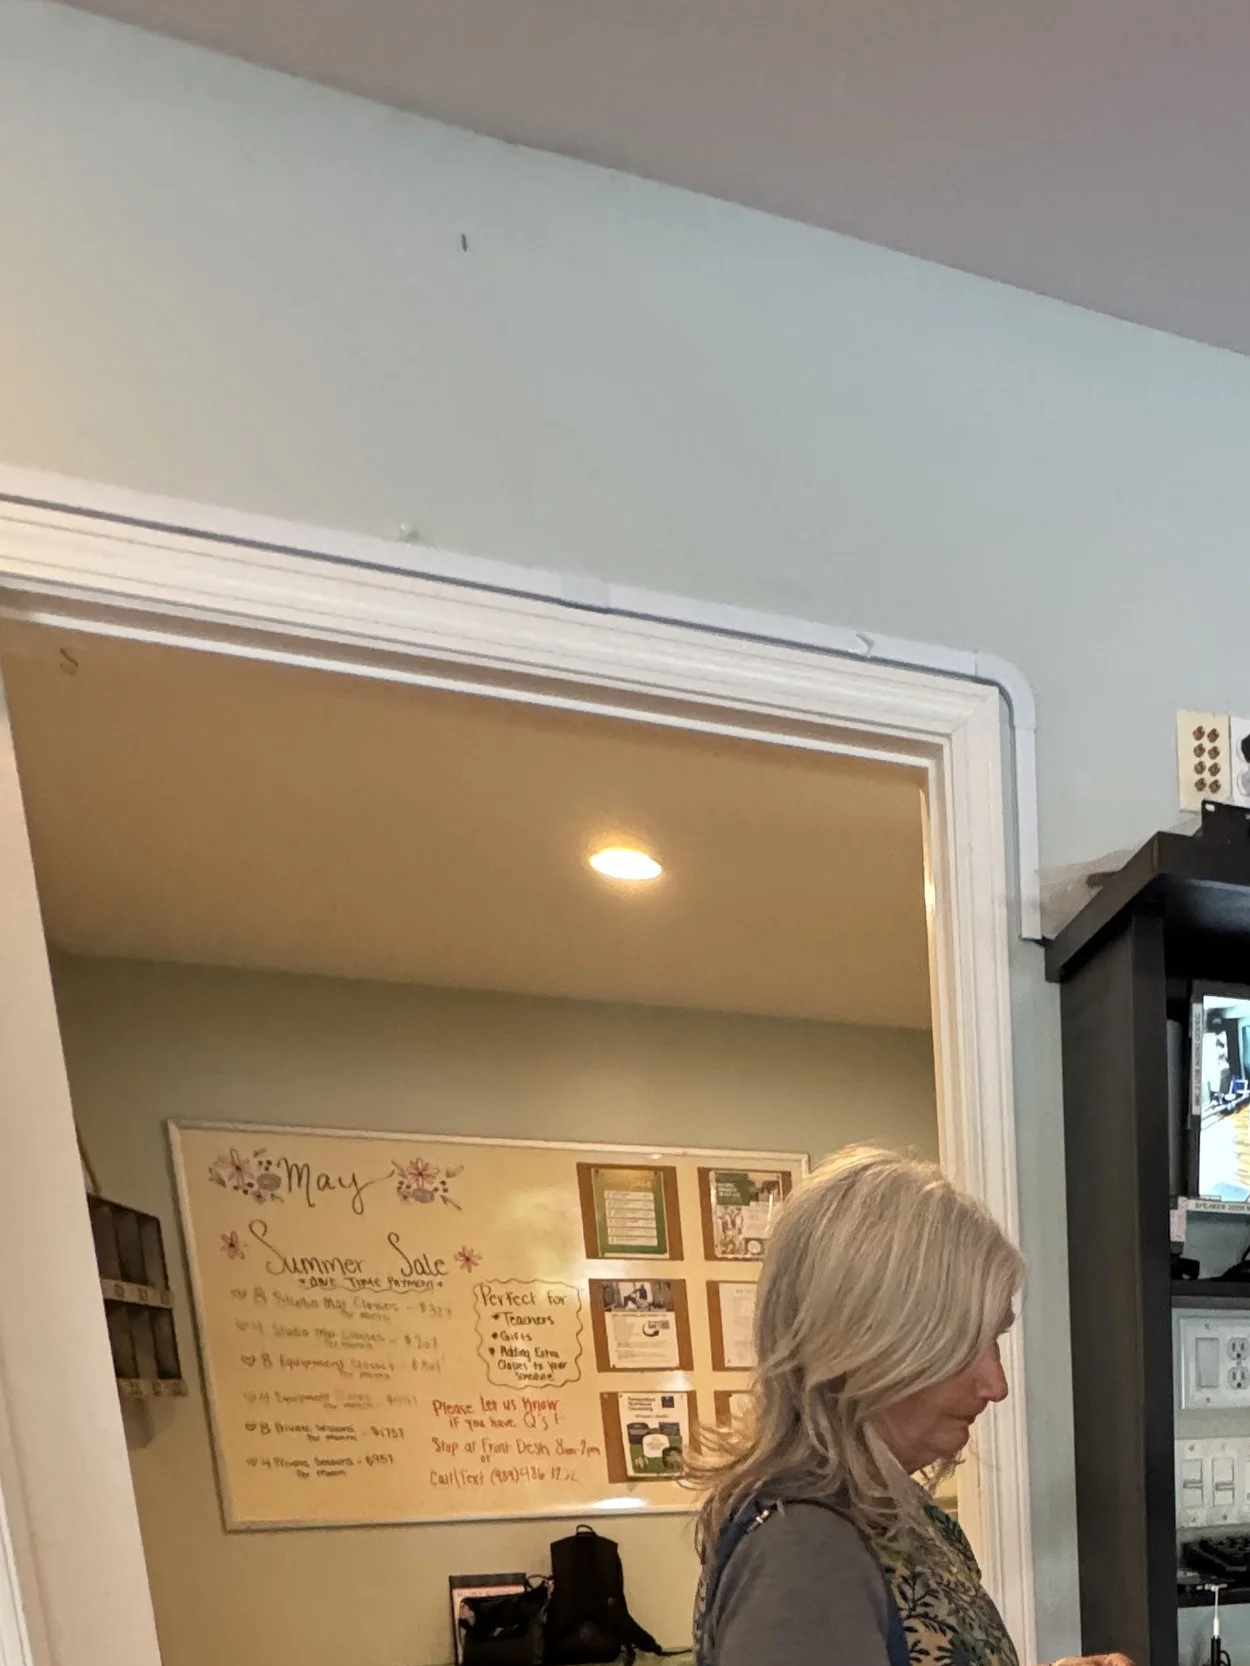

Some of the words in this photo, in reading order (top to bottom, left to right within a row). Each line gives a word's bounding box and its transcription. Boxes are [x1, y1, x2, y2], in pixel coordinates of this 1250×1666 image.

[277, 1157, 394, 1215] May
[249, 1219, 364, 1275] Summer
[387, 1231, 449, 1277] Sale
[480, 1283, 536, 1307] Perfect
[496, 1311, 554, 1326] Teachers
[500, 1330, 532, 1341] Gifts
[432, 1399, 474, 1417] Please
[503, 1399, 517, 1411] us
[465, 1418, 485, 1432] you
[489, 1416, 517, 1429] have
[431, 1437, 459, 1456] Stop
[464, 1441, 477, 1453] at
[480, 1454, 490, 1463] or
